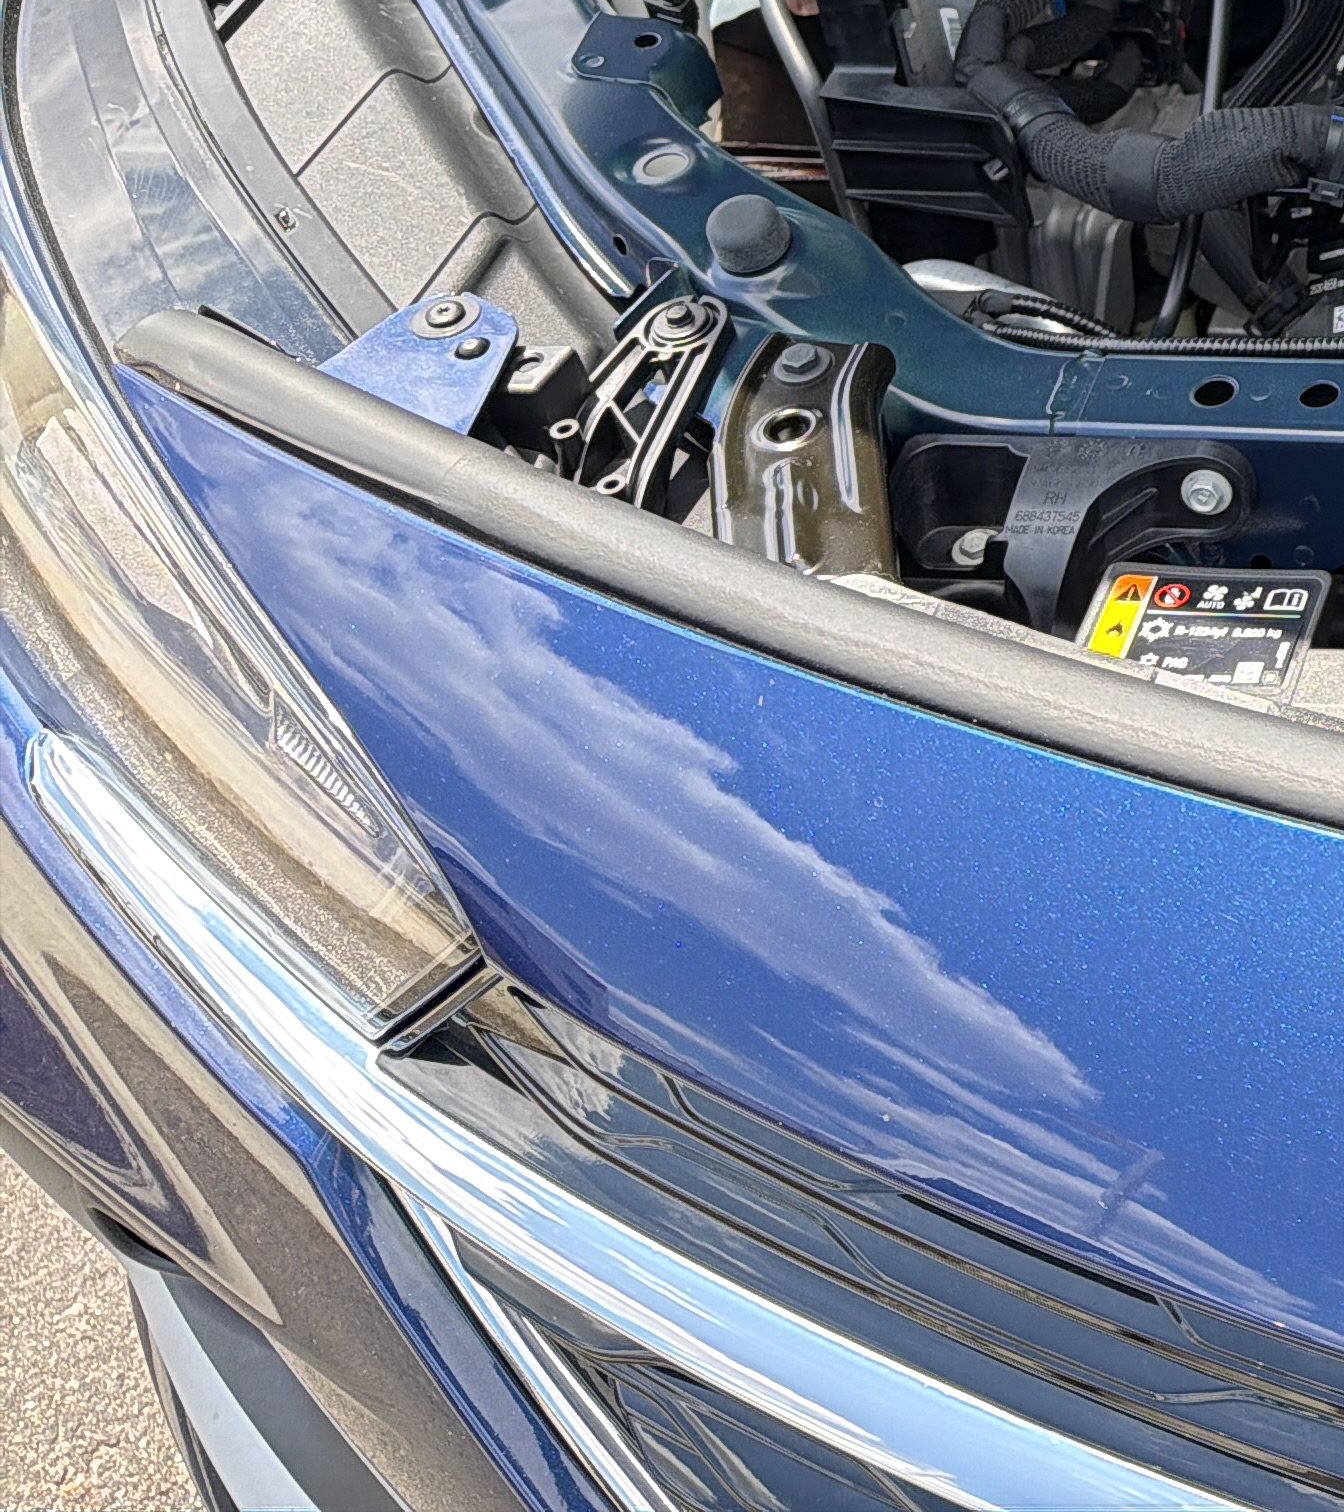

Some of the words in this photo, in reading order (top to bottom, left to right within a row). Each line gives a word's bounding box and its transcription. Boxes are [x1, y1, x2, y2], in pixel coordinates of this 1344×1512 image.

[1004, 524, 1030, 534] MADE
[1046, 525, 1075, 535] KOREA
[1196, 600, 1225, 610] AUTO
